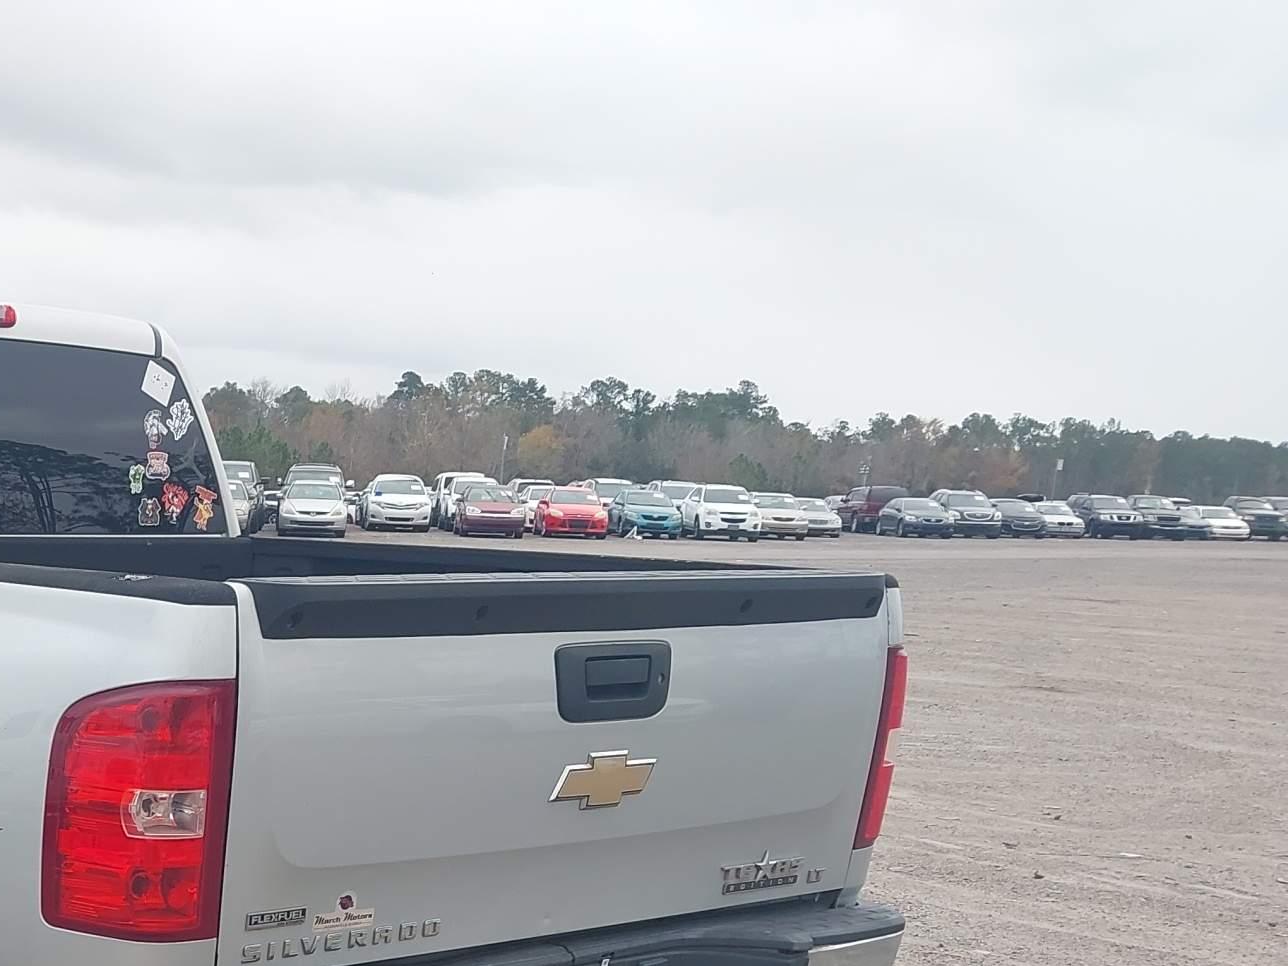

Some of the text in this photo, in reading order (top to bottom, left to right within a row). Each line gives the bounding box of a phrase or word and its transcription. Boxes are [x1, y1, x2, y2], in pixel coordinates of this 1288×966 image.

[807, 867, 826, 884] LT
[250, 909, 306, 926] FLEXFUEL
[343, 911, 373, 923] Motors
[241, 918, 441, 964] SILVERADO
